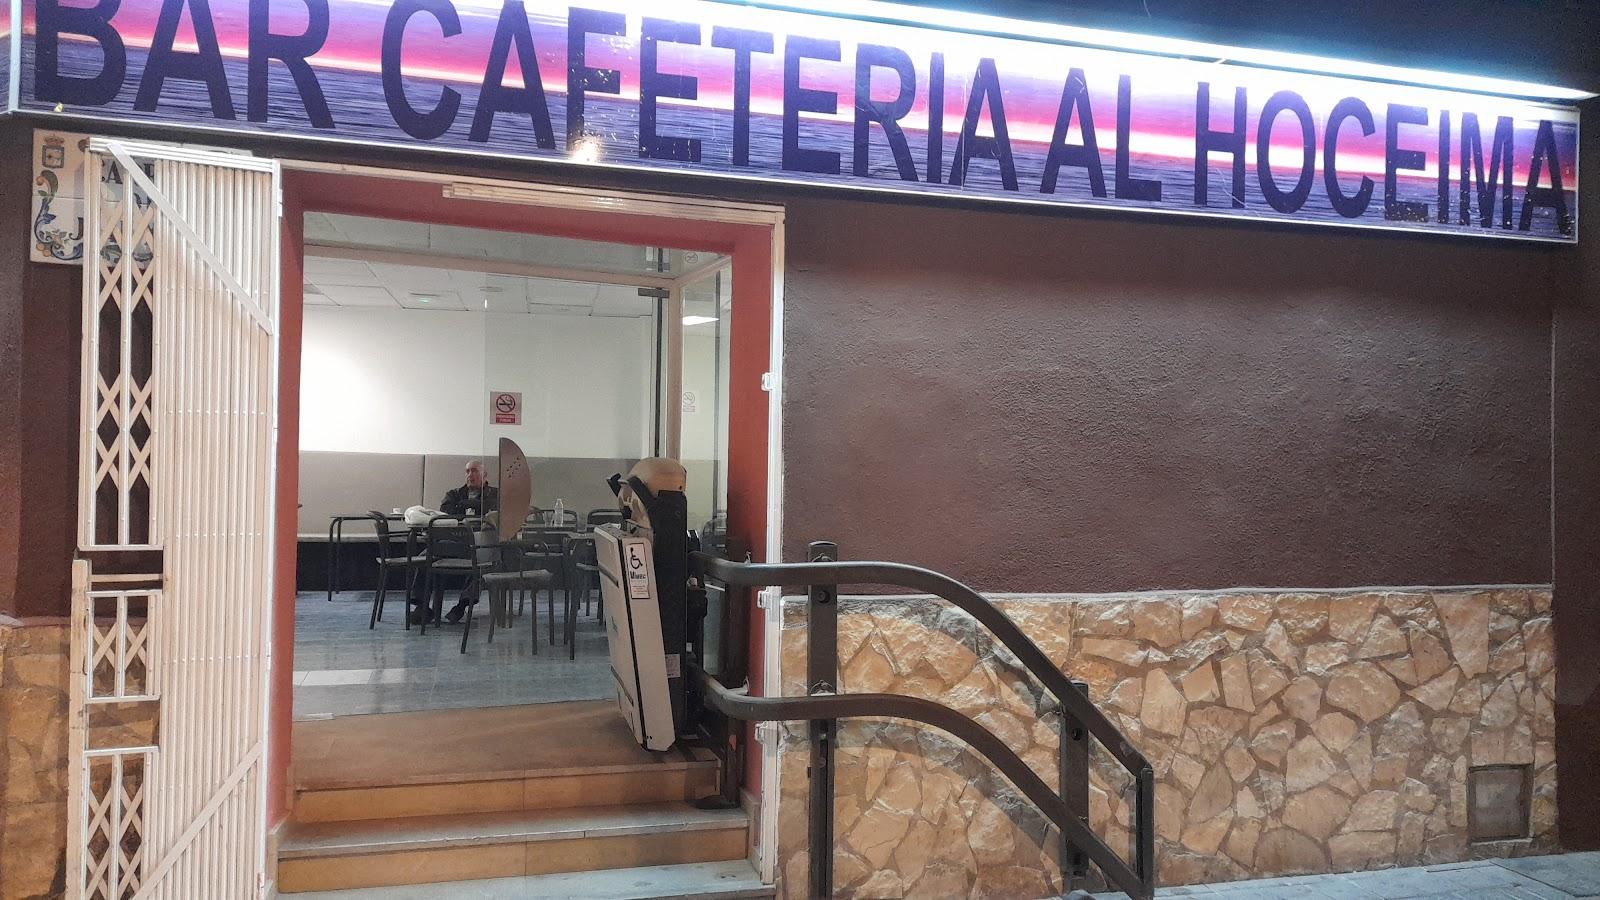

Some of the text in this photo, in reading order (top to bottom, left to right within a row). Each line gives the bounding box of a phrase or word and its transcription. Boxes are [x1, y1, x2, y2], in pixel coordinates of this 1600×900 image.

[35, 0, 1575, 236] BAR CAFETERIA AL HOCEIMA
